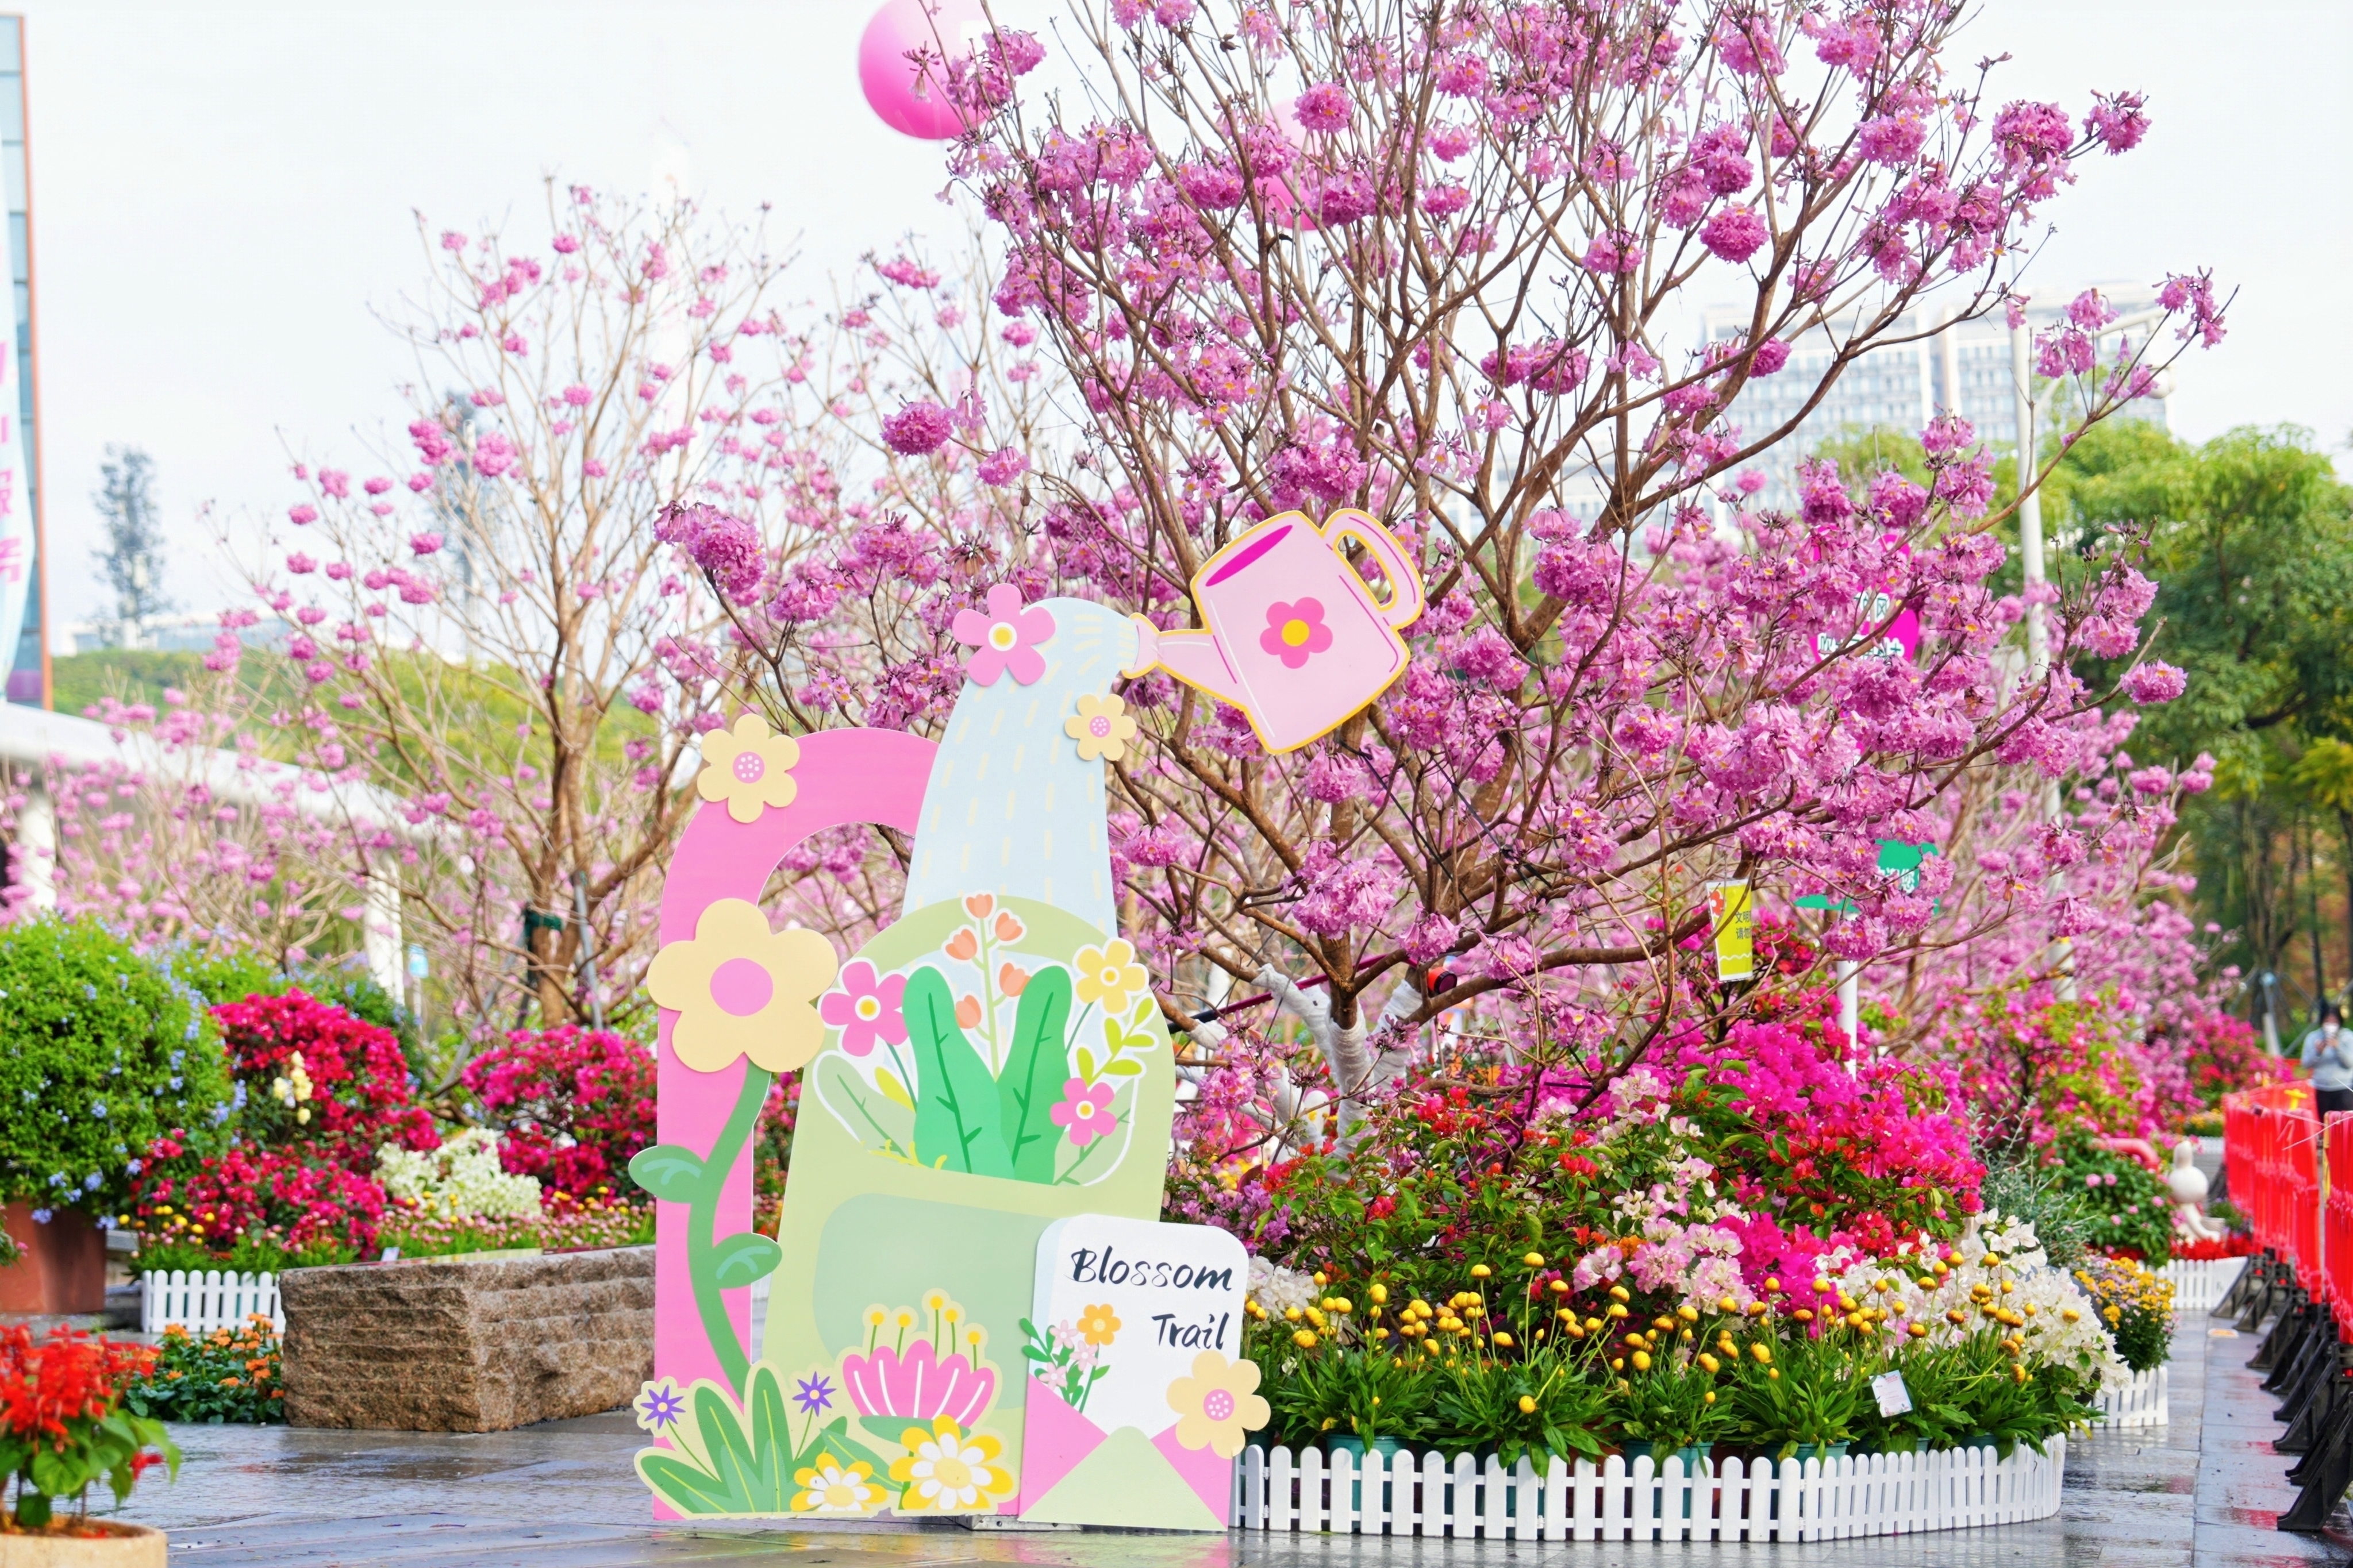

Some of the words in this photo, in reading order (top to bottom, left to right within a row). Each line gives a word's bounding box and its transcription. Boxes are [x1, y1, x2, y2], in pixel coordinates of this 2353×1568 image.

[1735, 910, 1751, 923] 文明
[1736, 927, 1752, 939] 请勿
[1064, 1245, 1232, 1291] Blossom
[1151, 1312, 1229, 1350] Trail
